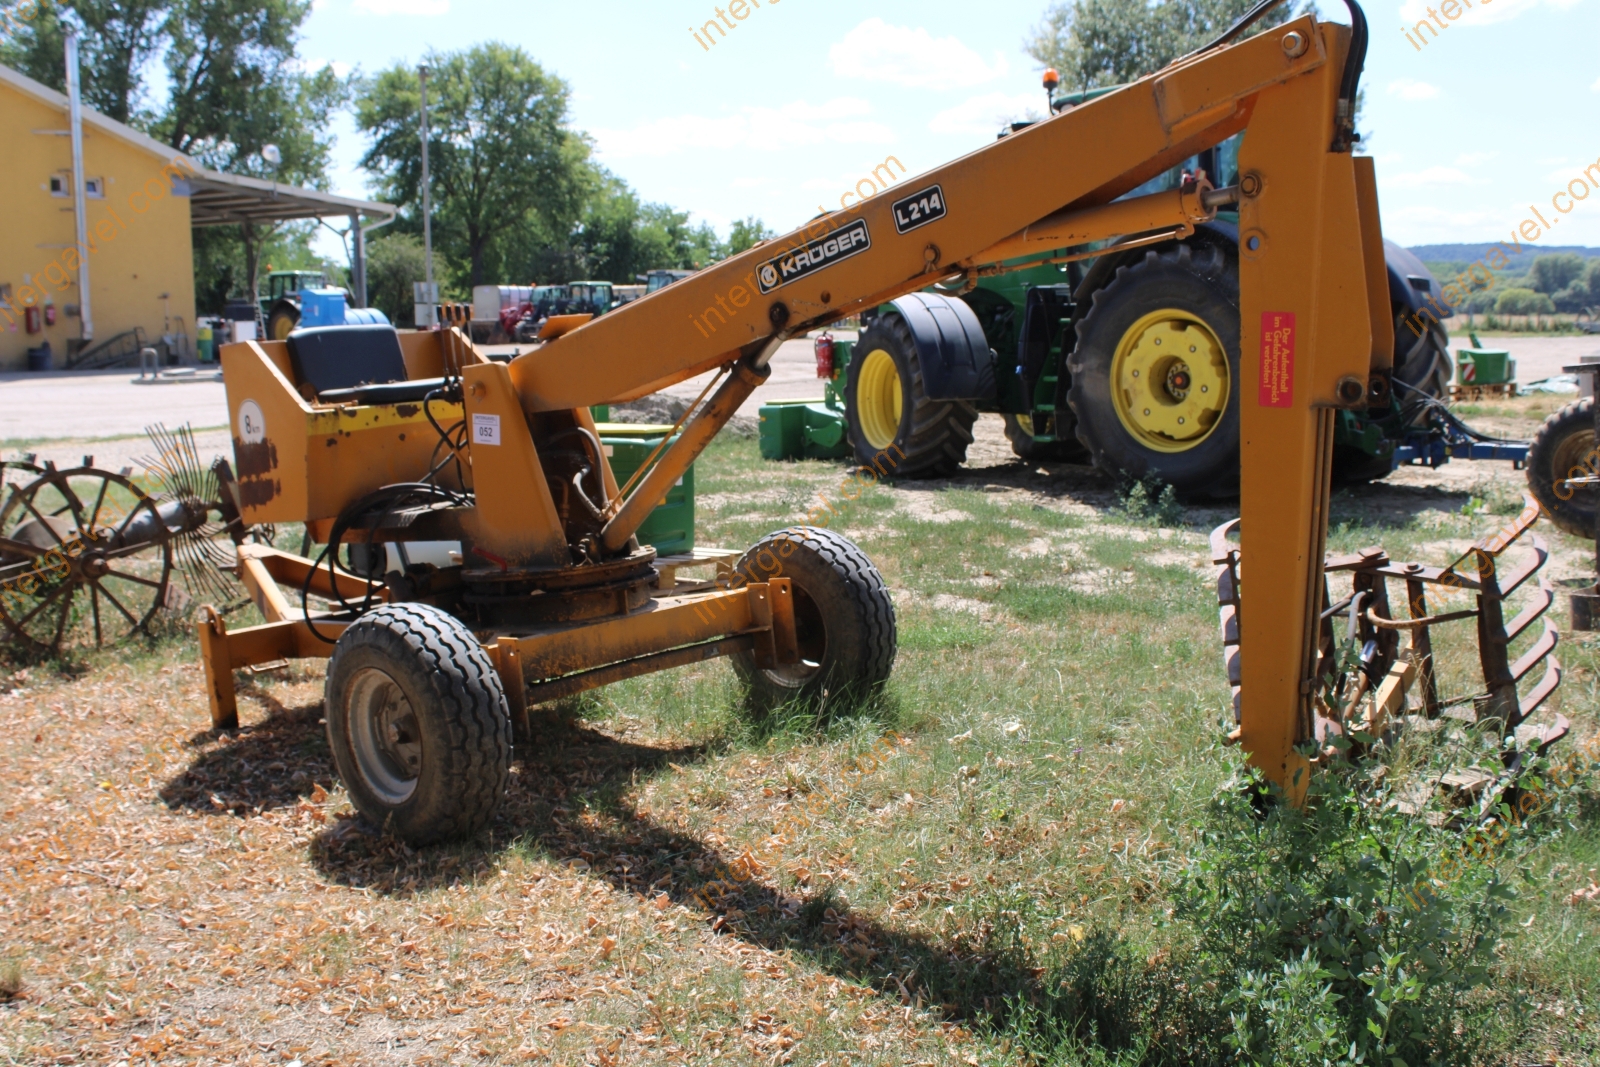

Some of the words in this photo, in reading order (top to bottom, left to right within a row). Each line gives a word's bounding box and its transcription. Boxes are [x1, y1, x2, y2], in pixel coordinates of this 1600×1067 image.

[896, 193, 941, 226] L214
[781, 227, 867, 277] KRÜGER
[1282, 328, 1291, 344] Der
[245, 414, 251, 434] 8
[479, 427, 493, 437] 052
